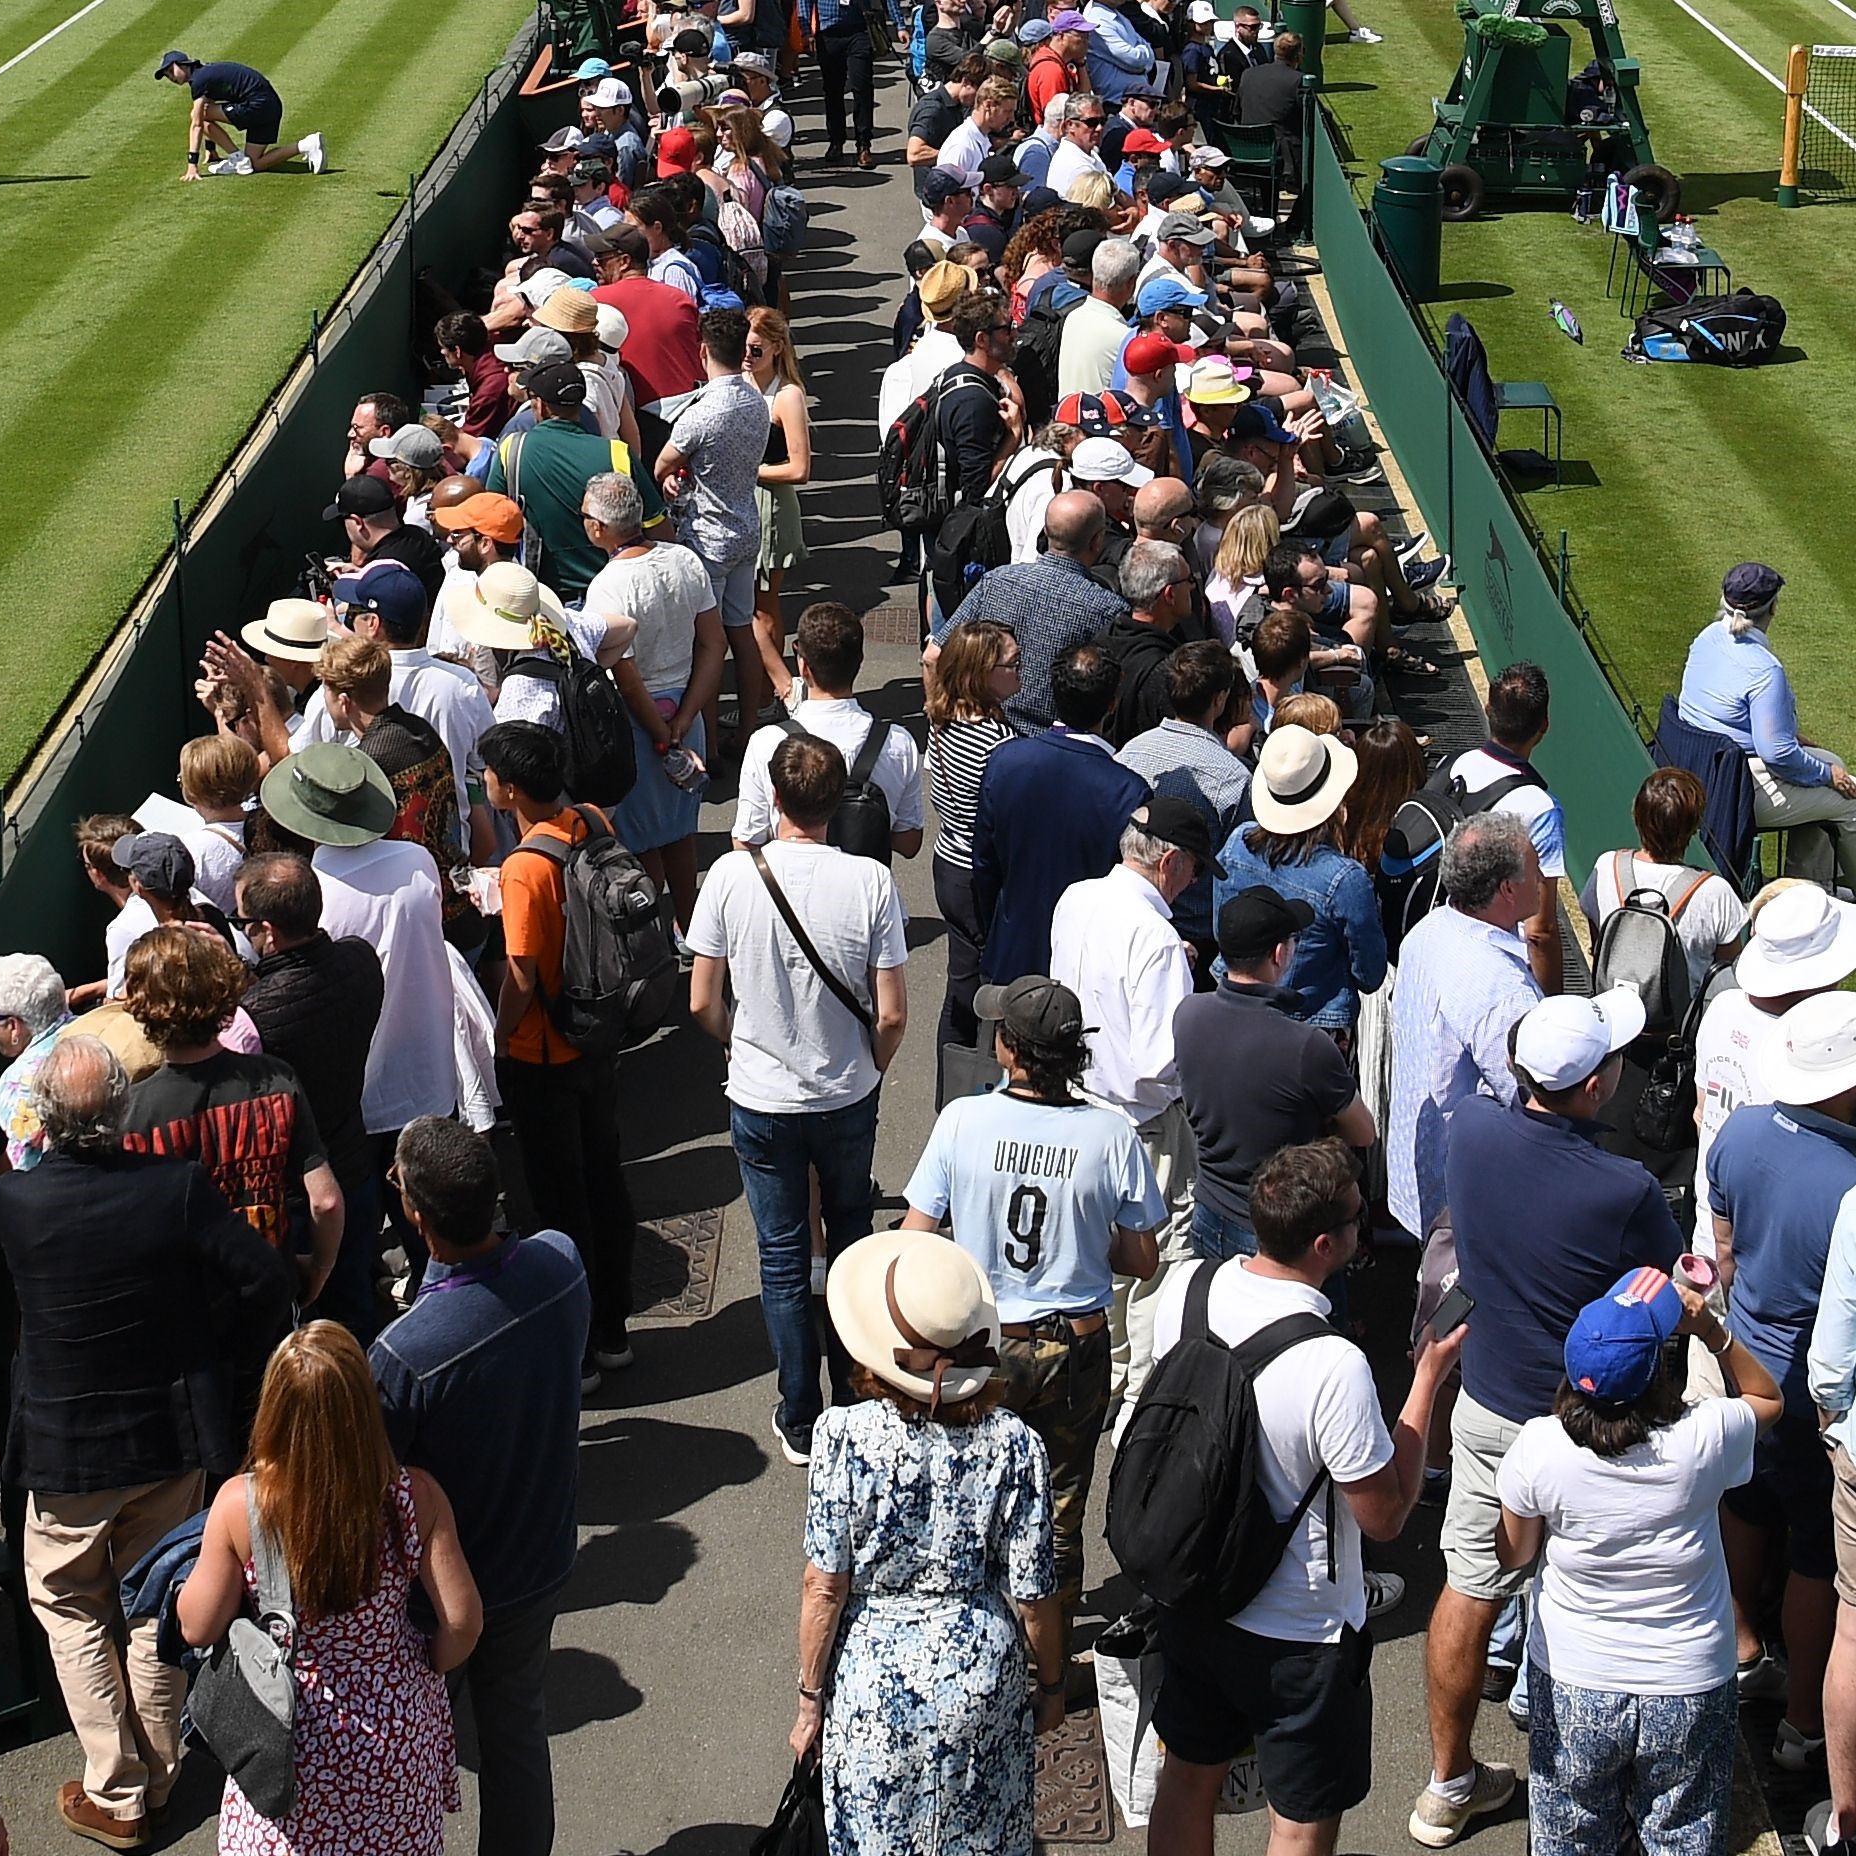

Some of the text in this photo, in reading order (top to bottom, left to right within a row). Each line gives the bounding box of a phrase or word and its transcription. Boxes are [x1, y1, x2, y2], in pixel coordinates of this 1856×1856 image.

[1707, 1081, 1745, 1112] FIL
[995, 1140, 1078, 1179] URUGUAY
[1004, 1184, 1047, 1273] 9
